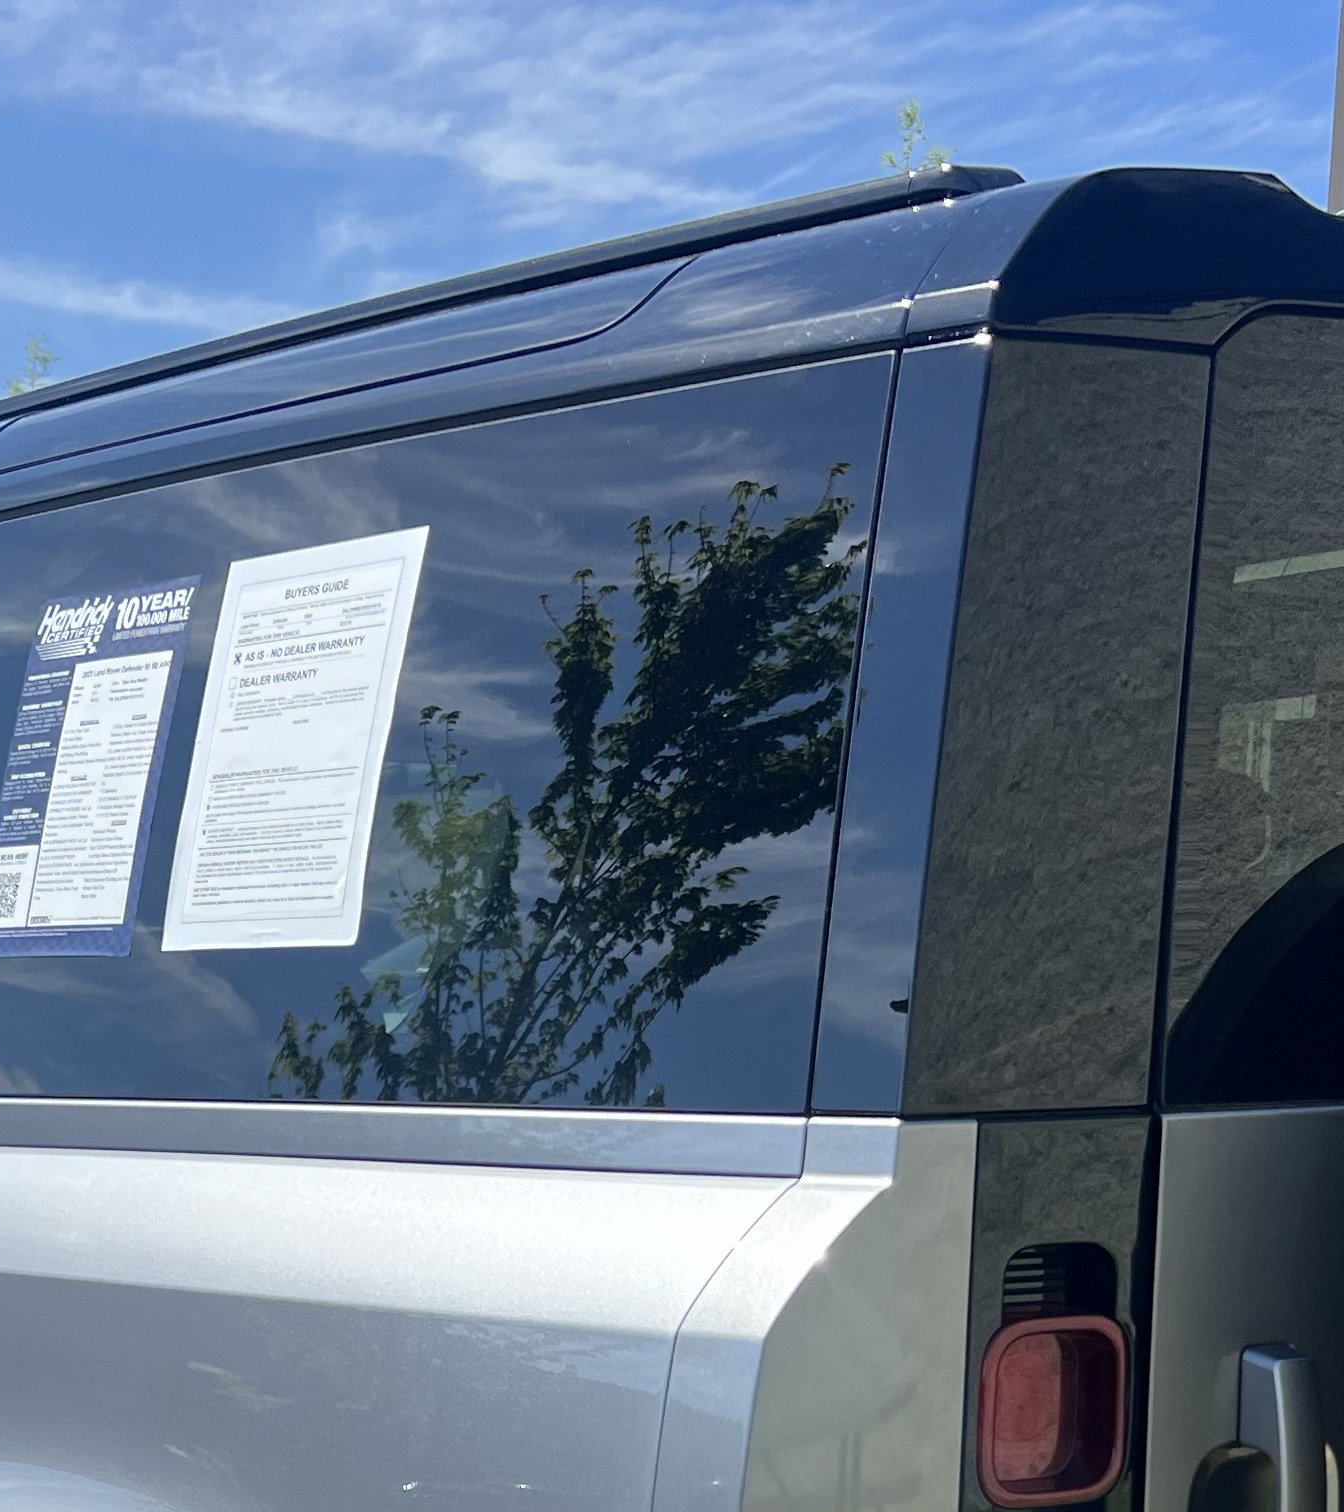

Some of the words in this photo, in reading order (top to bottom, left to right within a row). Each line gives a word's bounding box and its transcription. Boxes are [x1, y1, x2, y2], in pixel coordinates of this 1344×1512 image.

[285, 584, 321, 600] BUYERS
[321, 579, 350, 594] GUIDE
[115, 596, 140, 630] 10
[168, 606, 191, 622] MILE
[47, 624, 104, 642] CERTIFIED
[244, 651, 255, 662] AS
[257, 650, 265, 660] IS
[270, 647, 283, 659] NO
[284, 642, 316, 657] DEALER
[318, 635, 366, 651] WARRANTY
[239, 674, 271, 688] DEALER
[272, 669, 318, 684] WARRANTY
